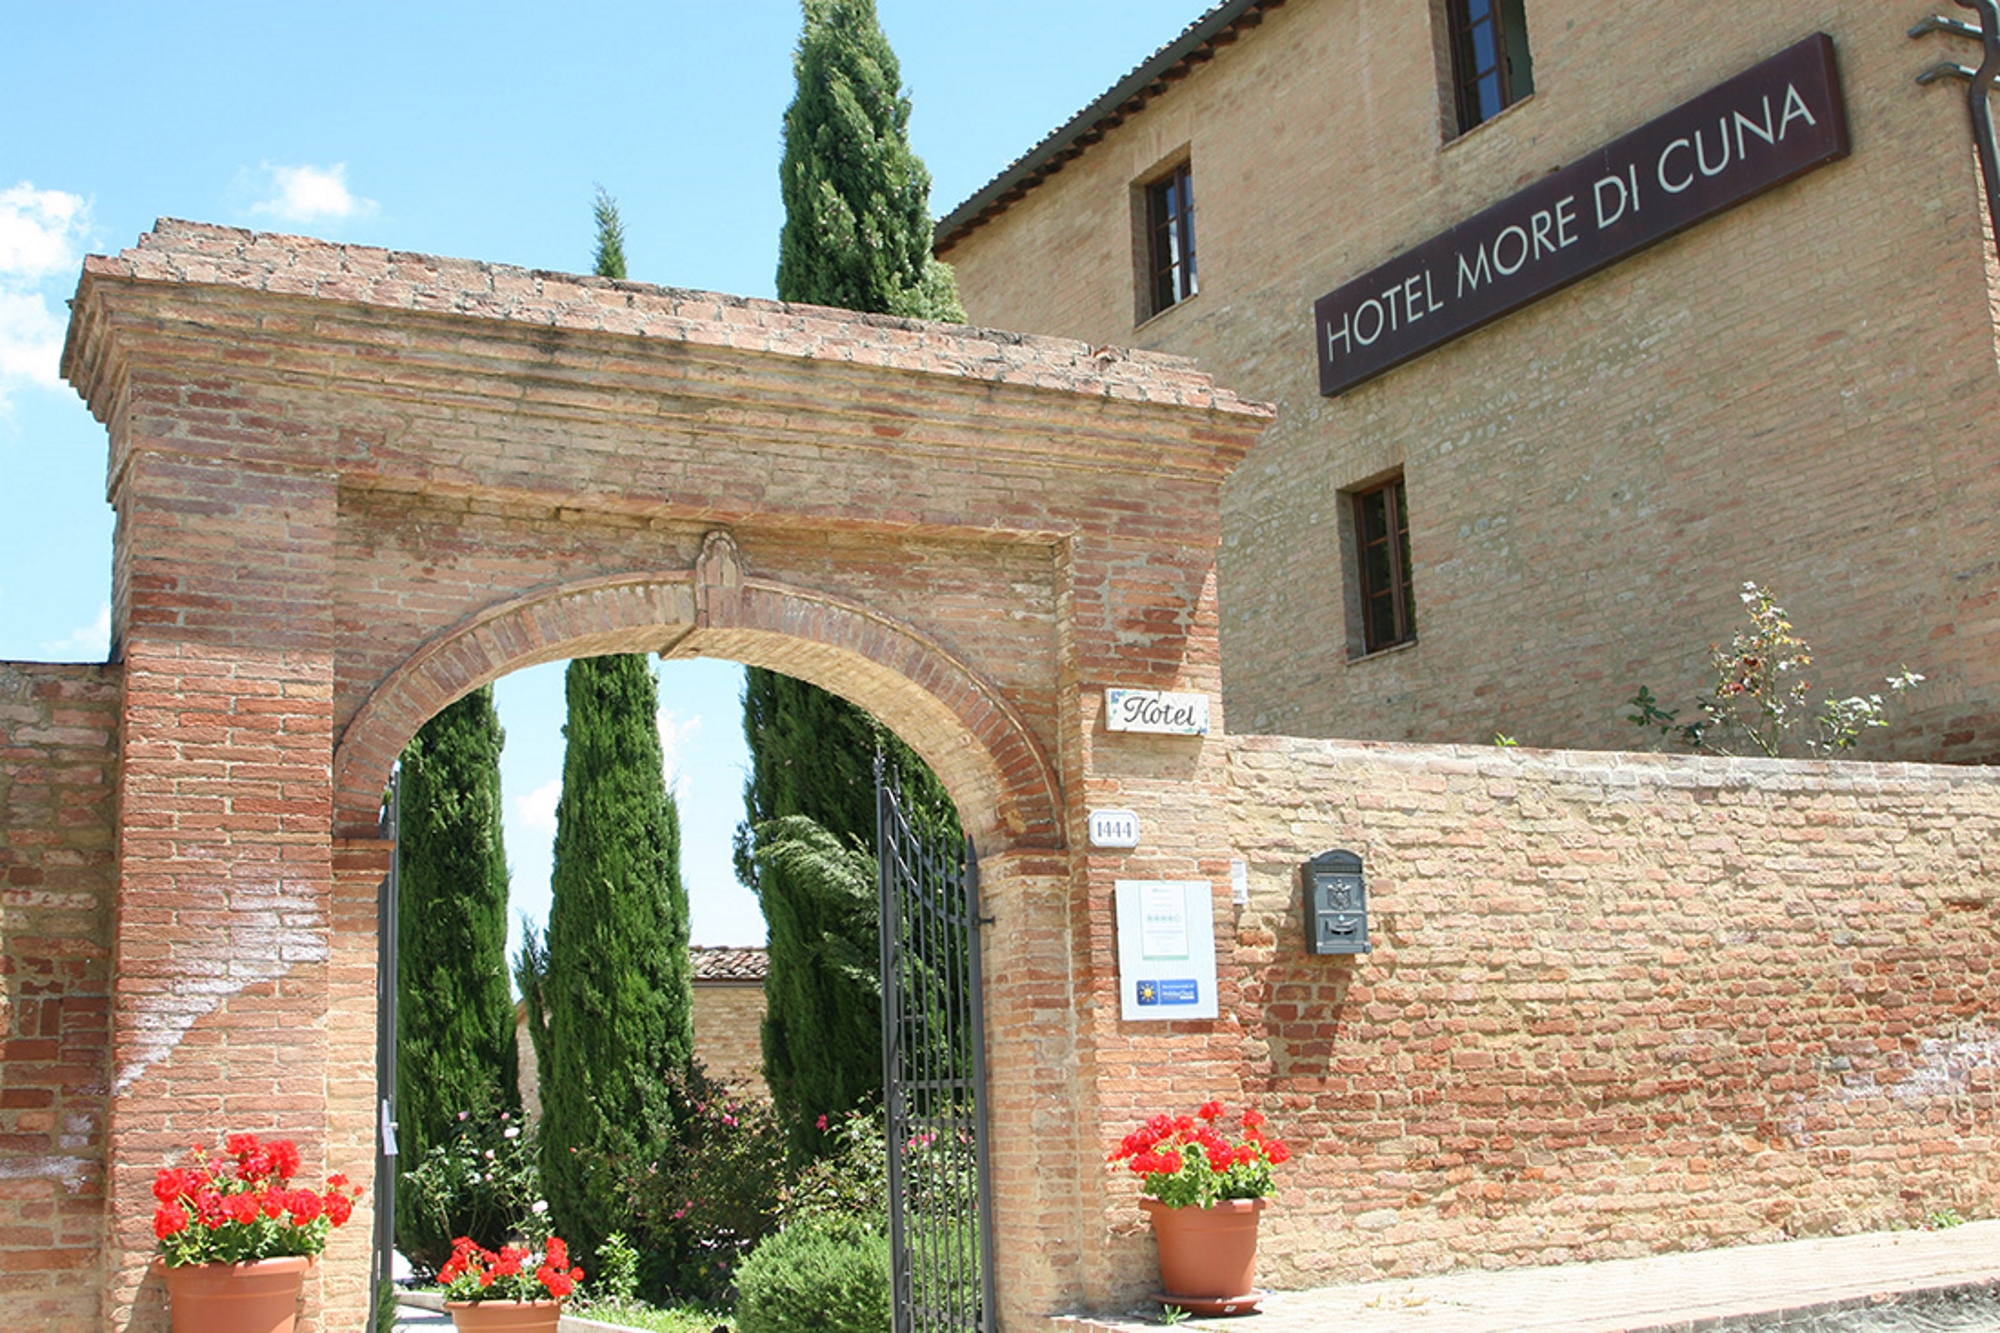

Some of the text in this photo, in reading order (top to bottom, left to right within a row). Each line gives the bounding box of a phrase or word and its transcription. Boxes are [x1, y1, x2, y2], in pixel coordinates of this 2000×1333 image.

[1326, 83, 1816, 361] HOTEL MORE DI CUNA
[1123, 696, 1196, 726] Hotel
[1097, 821, 1132, 838] 1444
